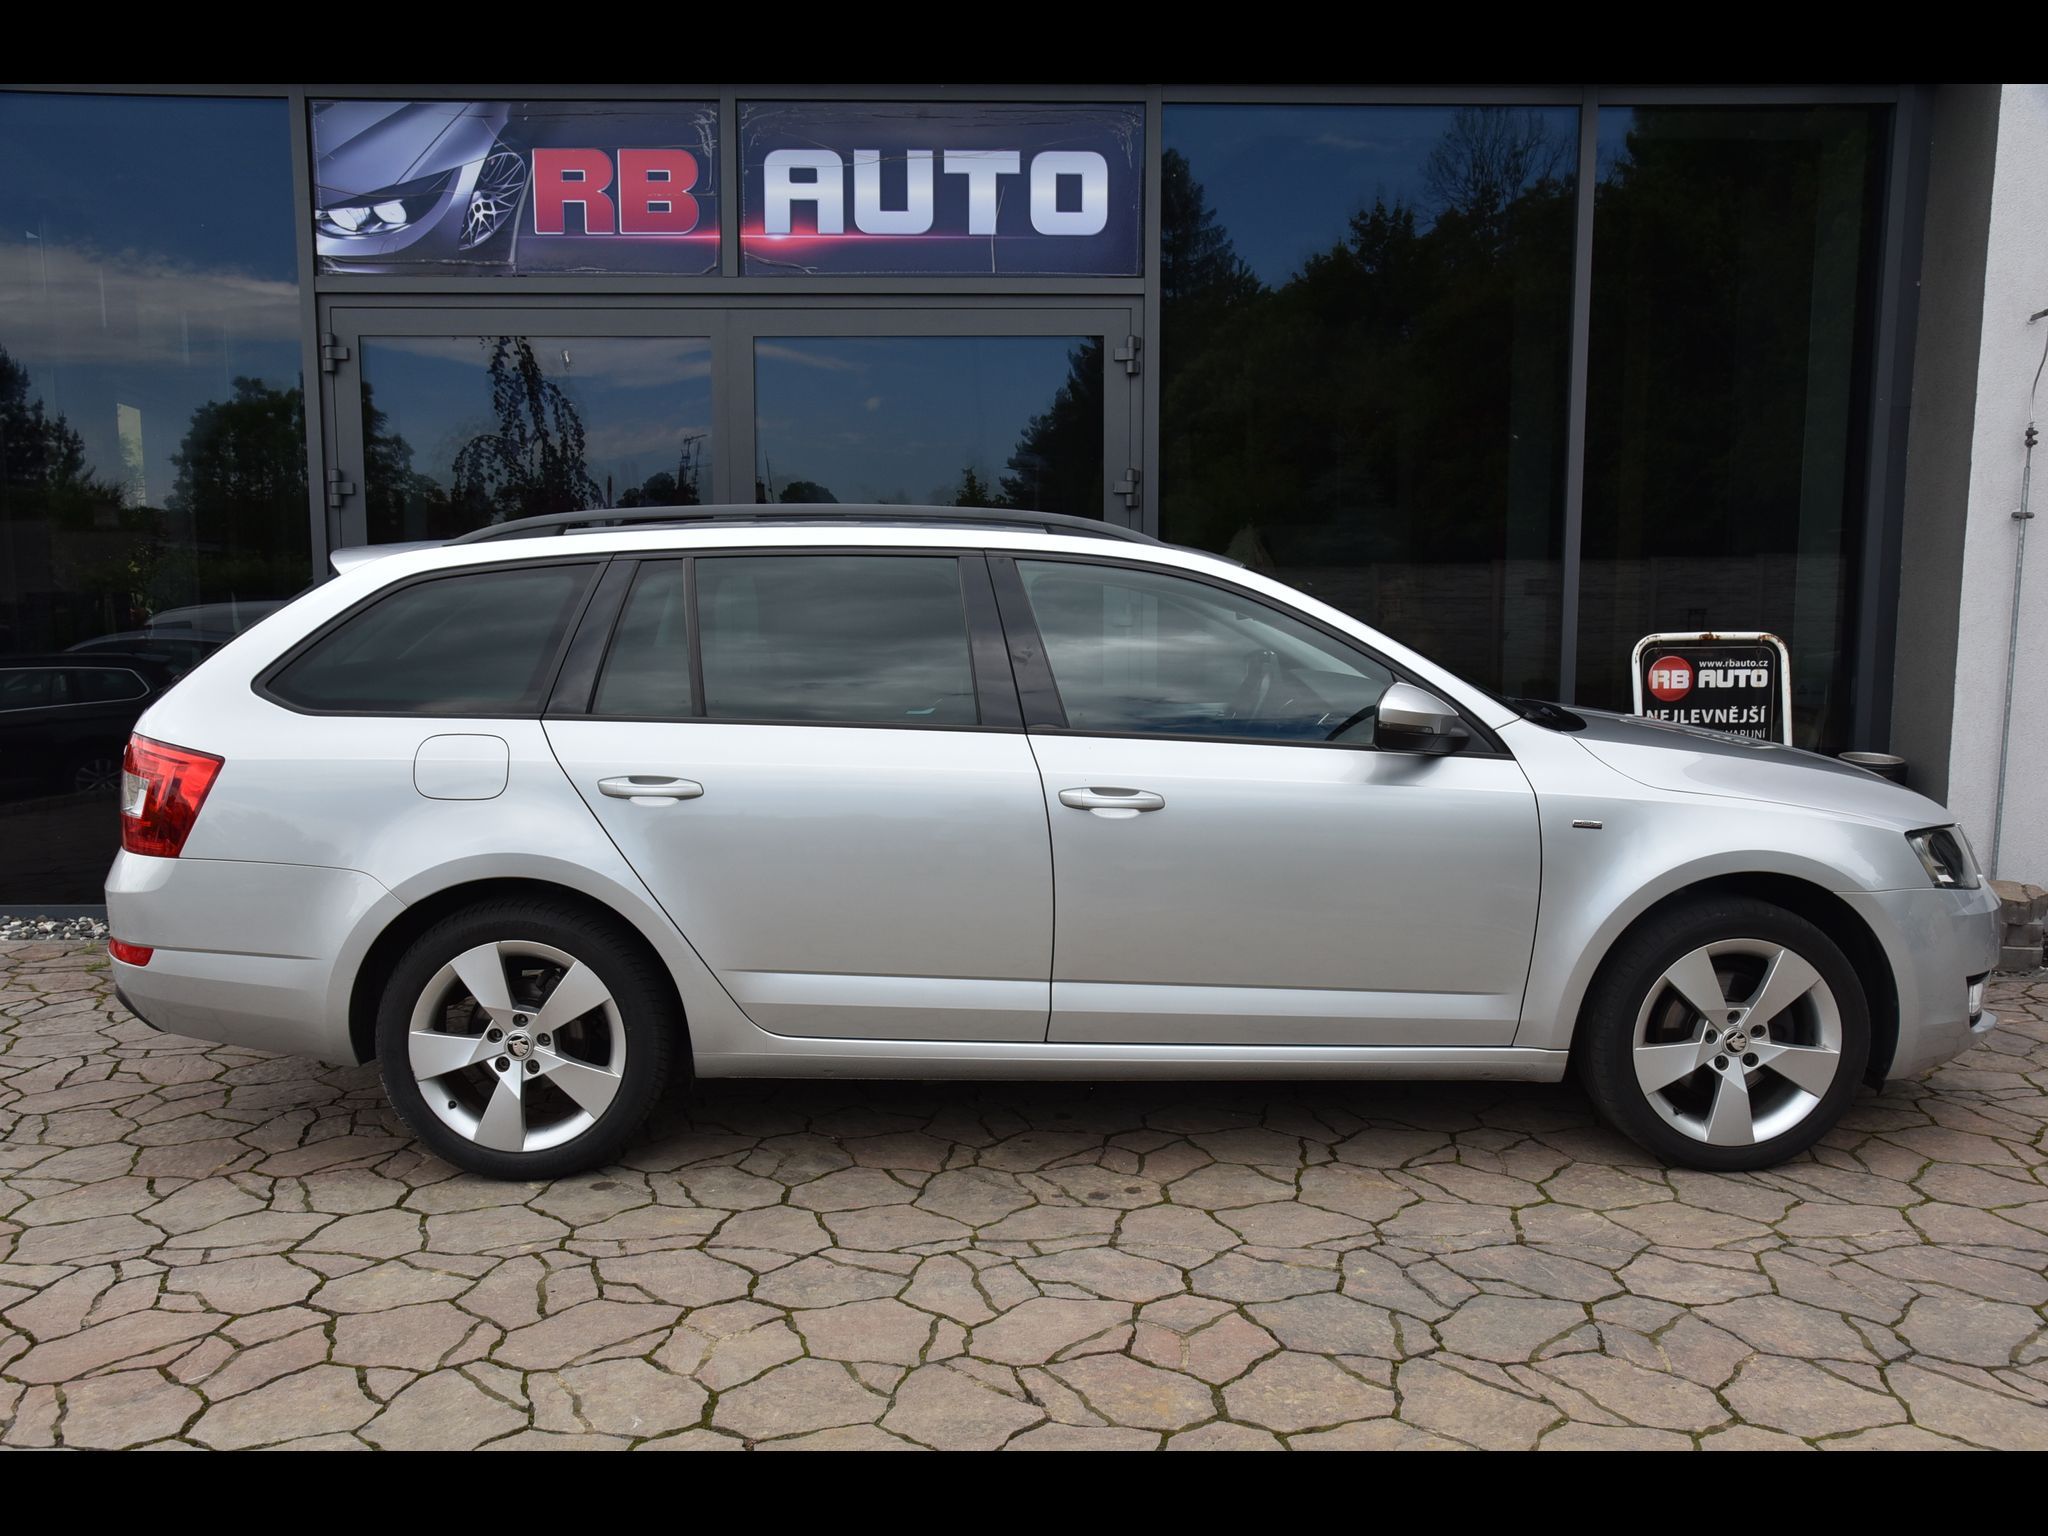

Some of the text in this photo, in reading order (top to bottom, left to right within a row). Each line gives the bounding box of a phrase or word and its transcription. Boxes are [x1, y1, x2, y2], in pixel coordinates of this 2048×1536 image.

[531, 147, 1109, 237] RB AUTO
[1699, 659, 1768, 668] www.rbauto.cz
[1651, 668, 1769, 690] RB AUTO
[1646, 705, 1767, 724] NEJLEVNĚJŠÍ
